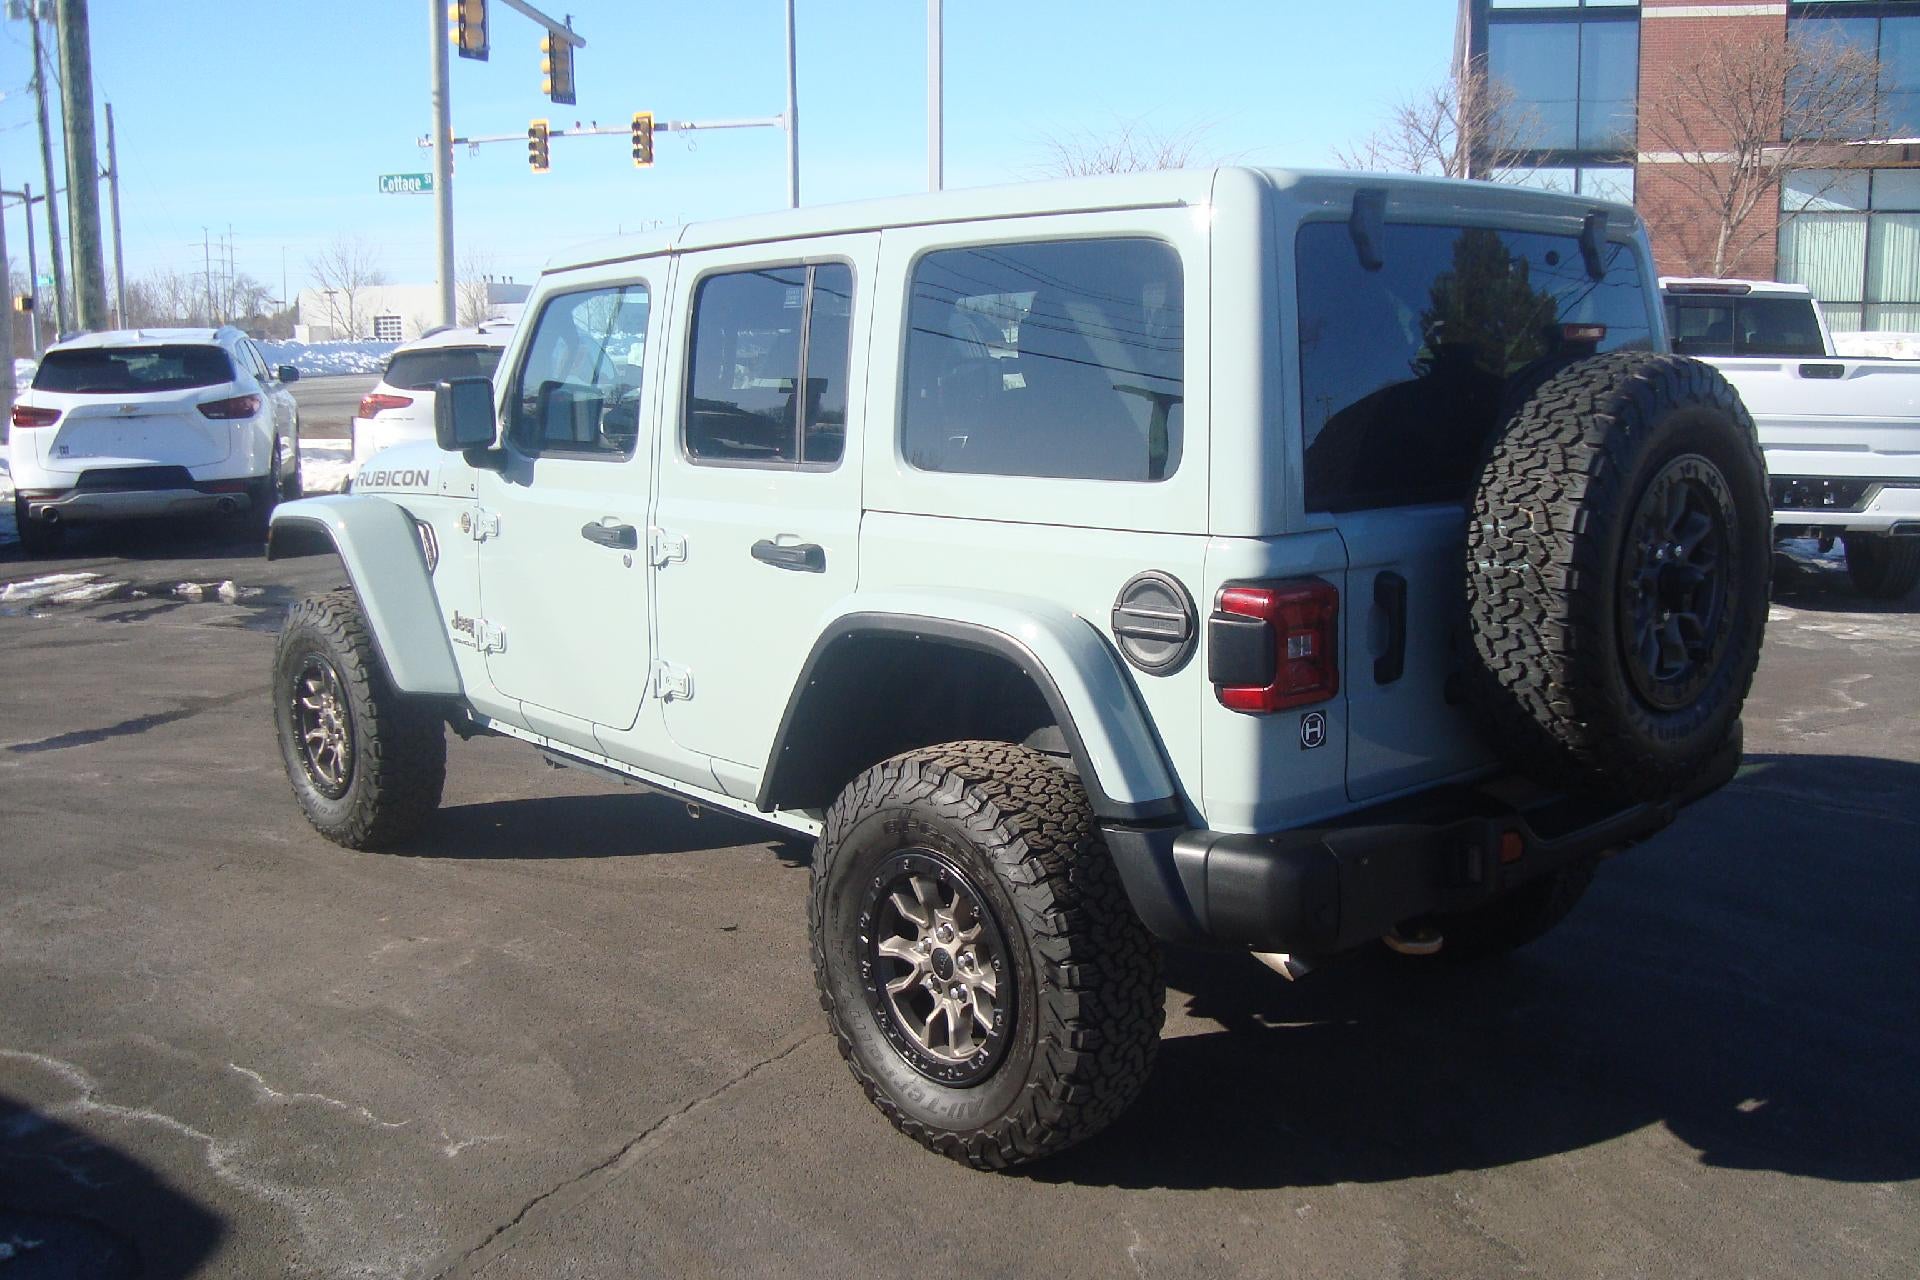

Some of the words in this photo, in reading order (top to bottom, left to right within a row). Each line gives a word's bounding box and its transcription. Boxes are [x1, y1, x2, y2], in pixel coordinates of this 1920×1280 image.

[380, 175, 421, 193] Cottage
[355, 469, 430, 487] RUBICON
[1305, 720, 1321, 741] H
